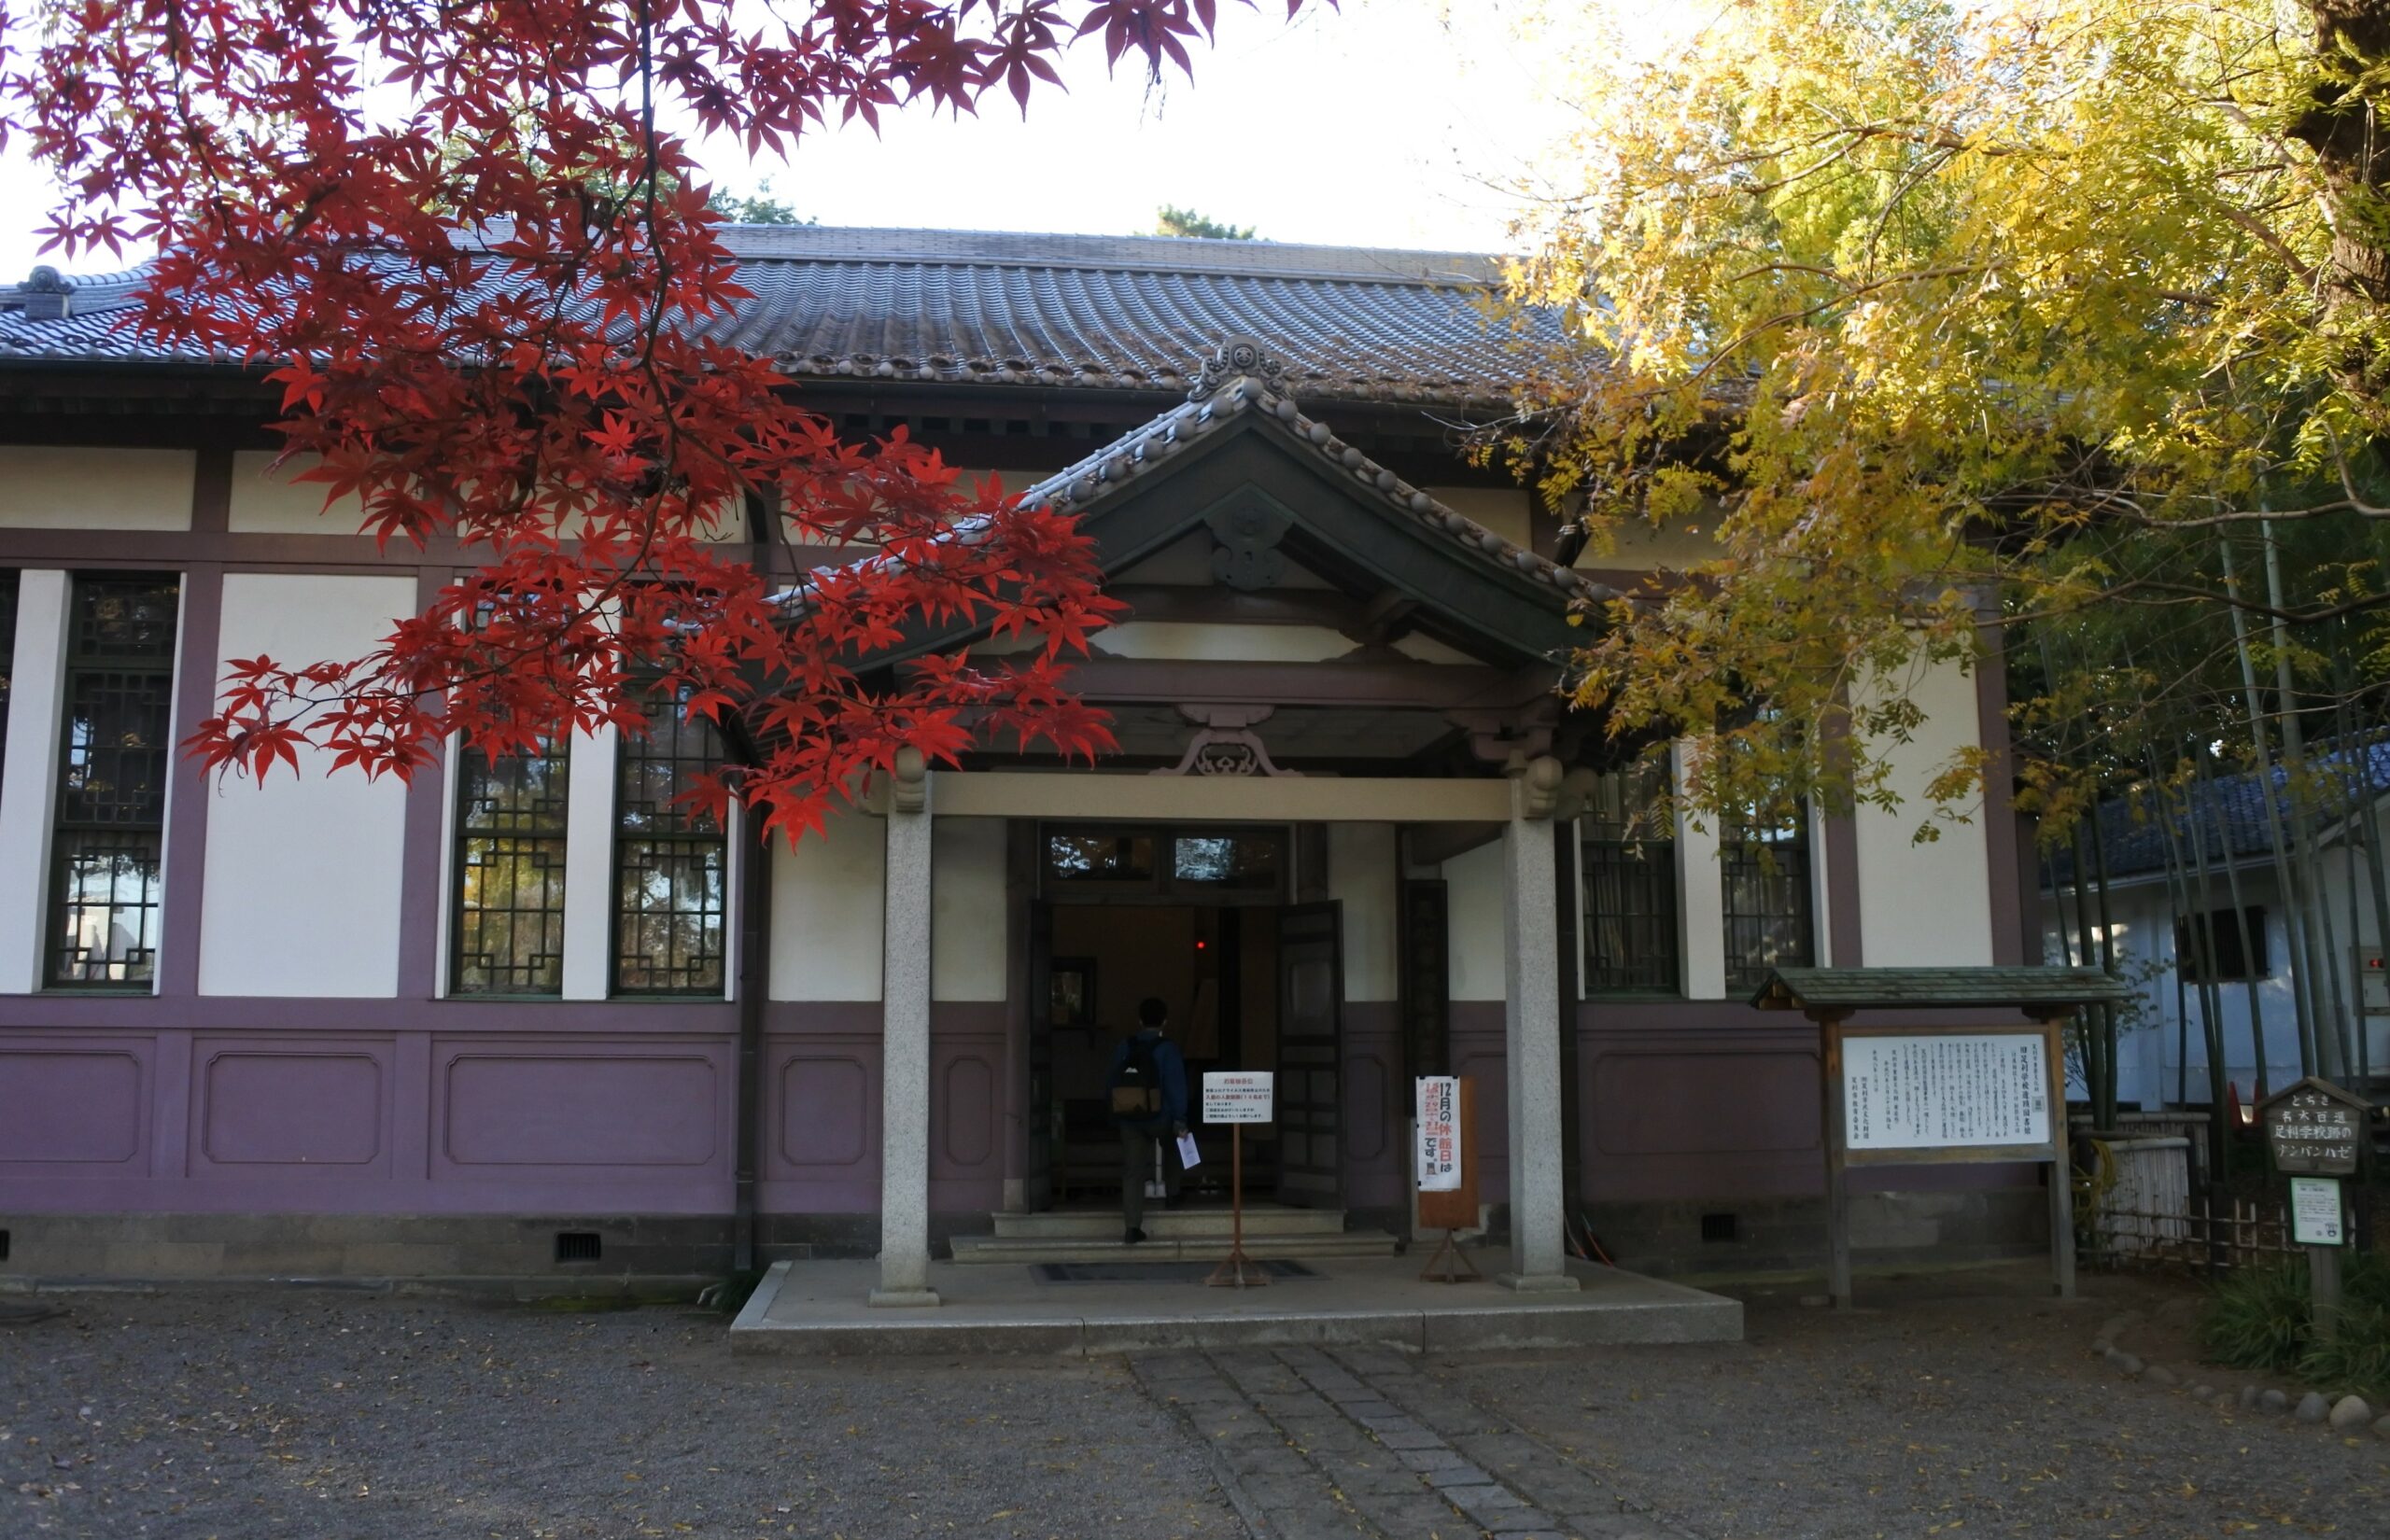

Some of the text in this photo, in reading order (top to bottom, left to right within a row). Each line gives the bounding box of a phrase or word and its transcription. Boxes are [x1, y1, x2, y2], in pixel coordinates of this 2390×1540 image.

[1440, 1082, 1453, 1173] 12月の休館日は
[2274, 1125, 2352, 1140] 足利学校跡の
[2278, 1144, 2353, 1159] ナンバンハゼ
